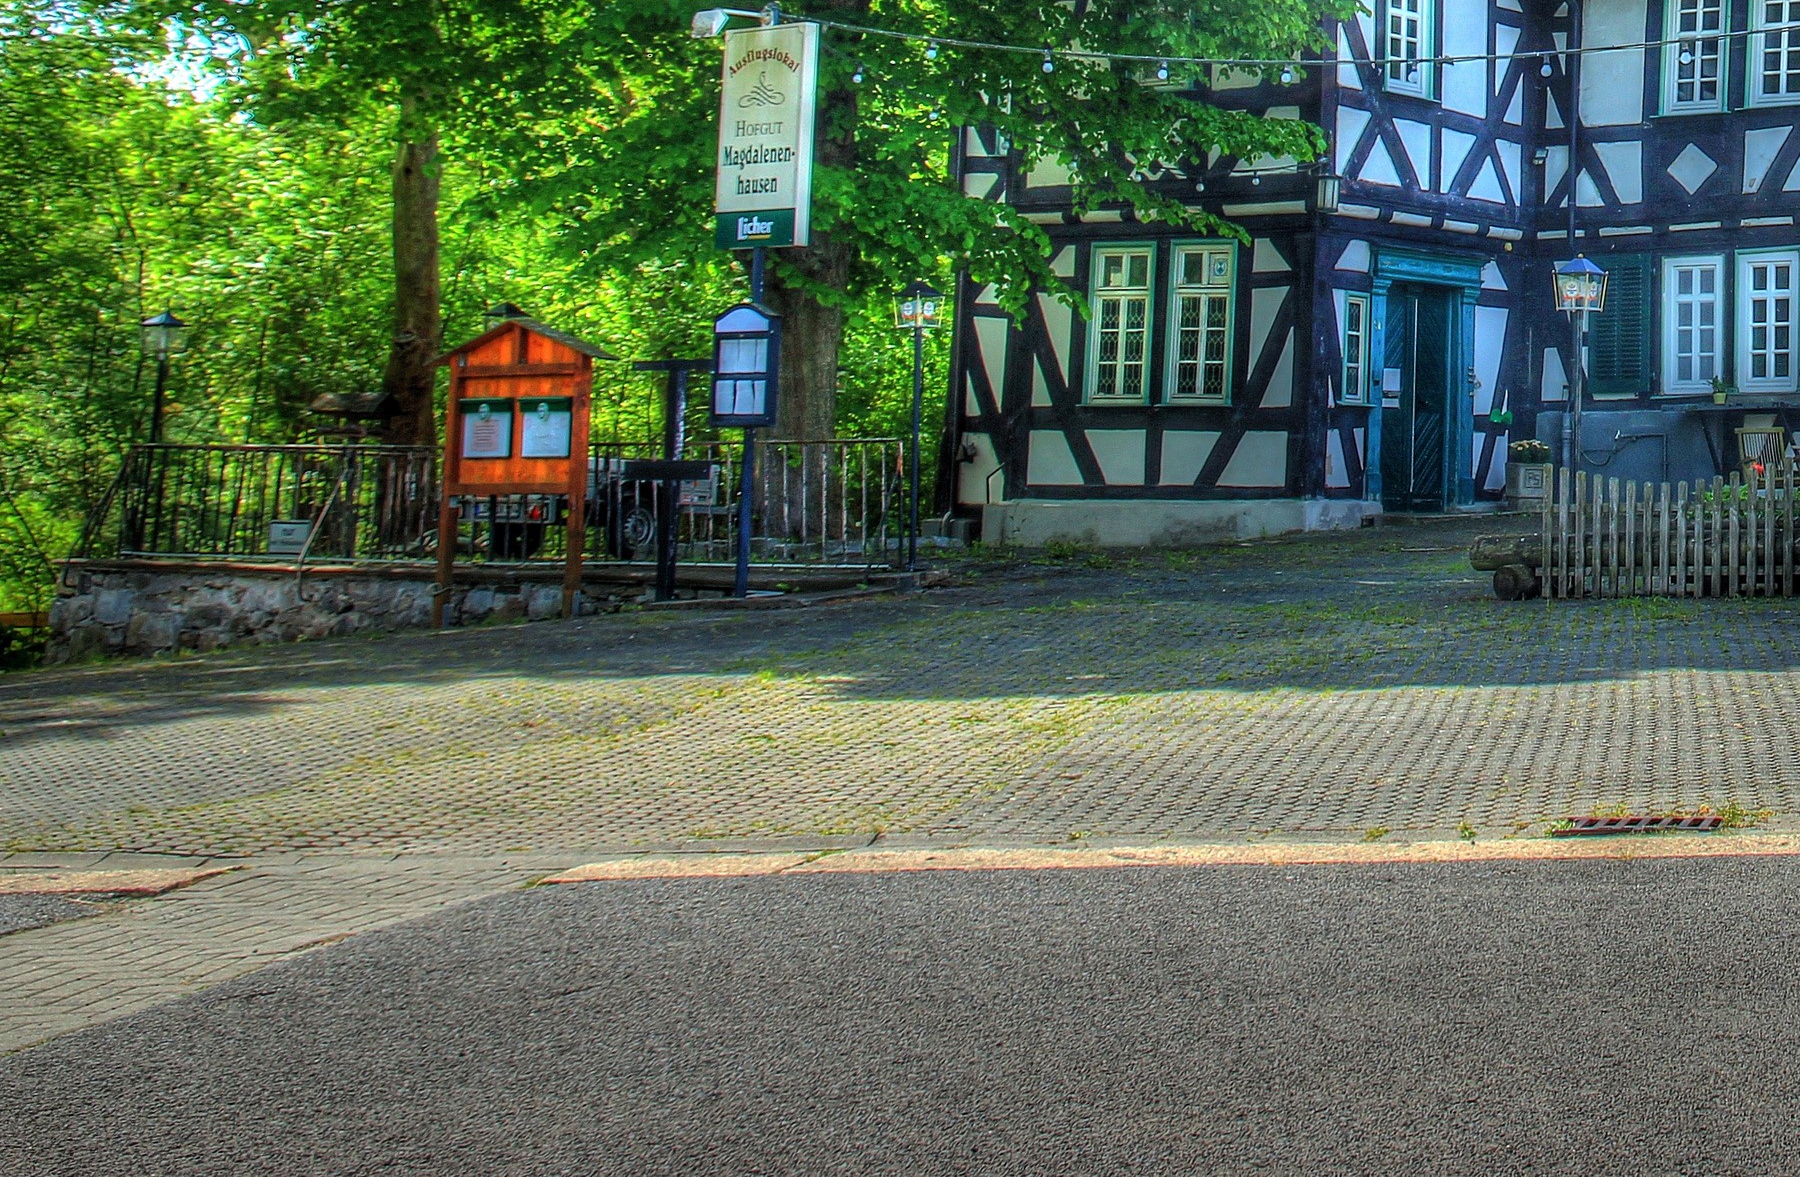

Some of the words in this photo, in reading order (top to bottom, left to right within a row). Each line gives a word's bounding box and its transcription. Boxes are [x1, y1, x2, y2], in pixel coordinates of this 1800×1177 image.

[729, 48, 800, 78] Ausflugslokal
[735, 120, 783, 137] HOFGUT
[722, 143, 795, 170] Magdalenen-
[736, 175, 777, 195] hausen
[737, 216, 774, 240] Licher
